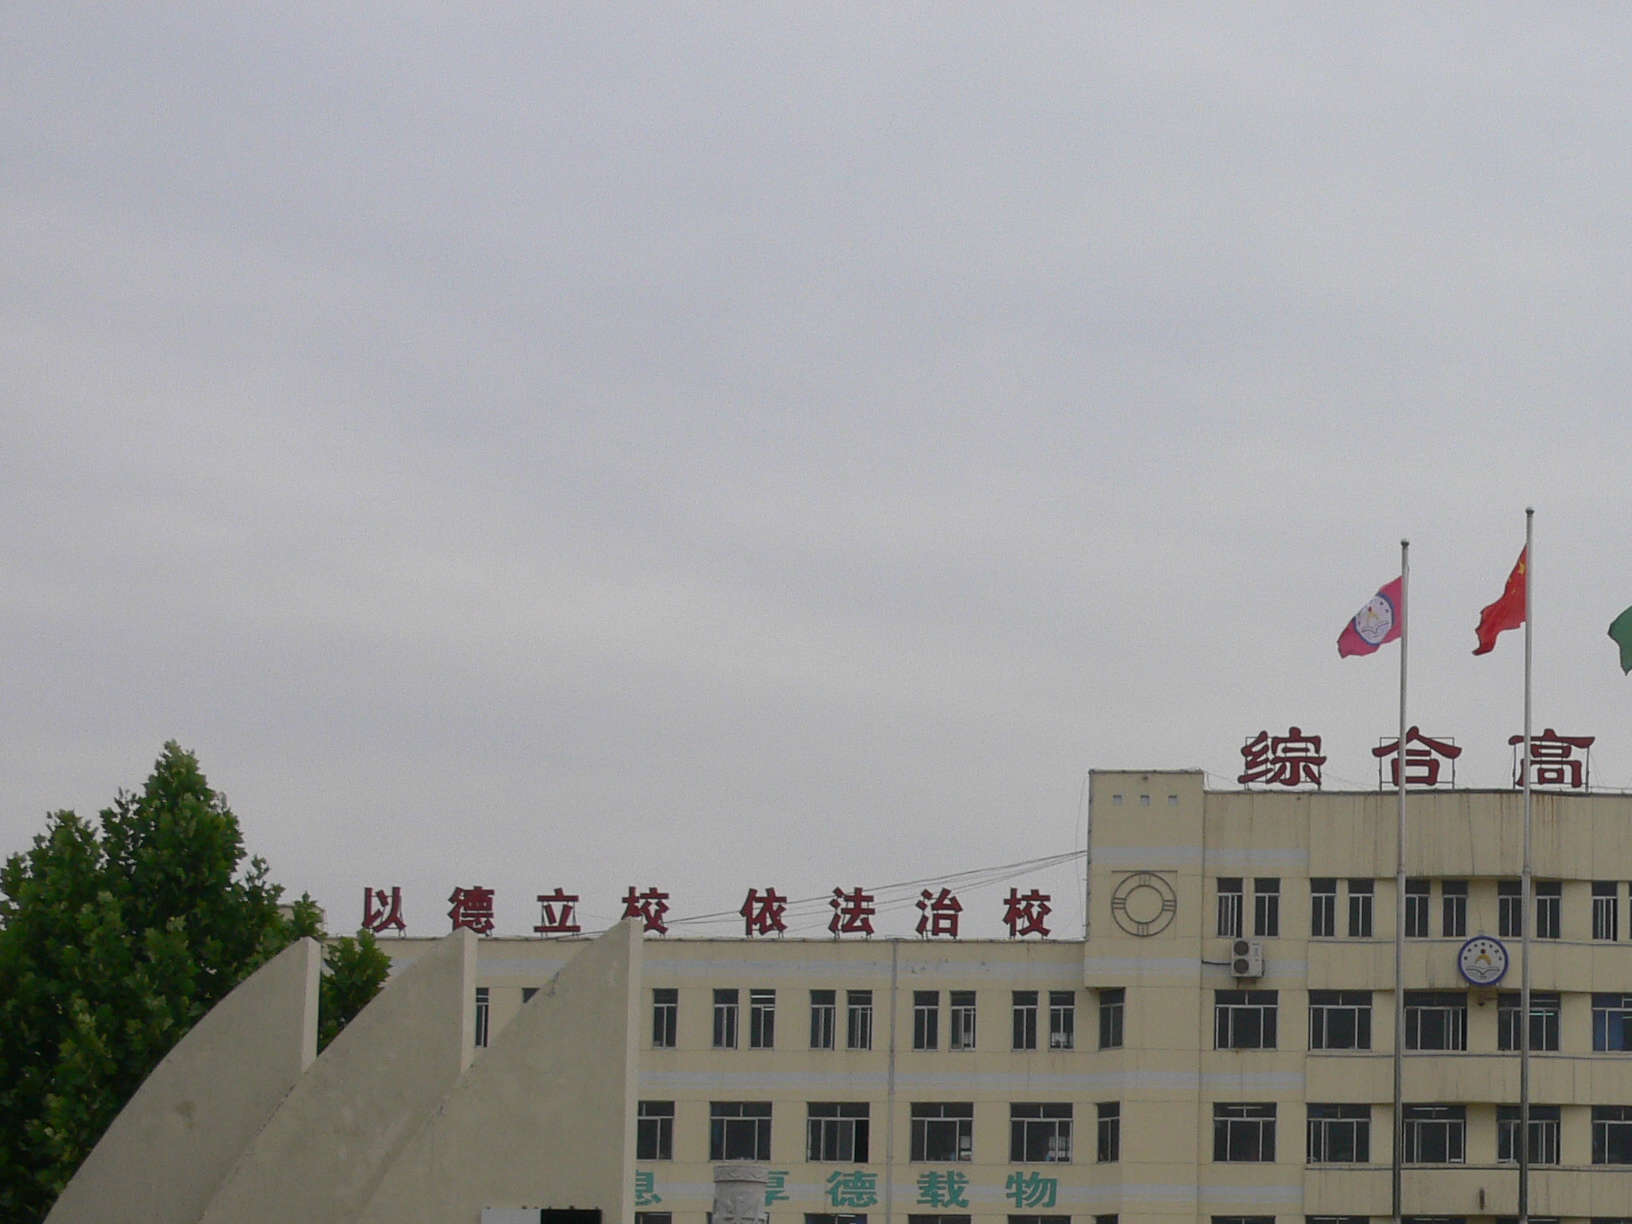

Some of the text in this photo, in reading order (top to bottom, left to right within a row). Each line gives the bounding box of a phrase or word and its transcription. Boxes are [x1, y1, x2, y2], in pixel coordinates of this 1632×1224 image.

[361, 886, 1052, 937] 以德立校 依法治校
